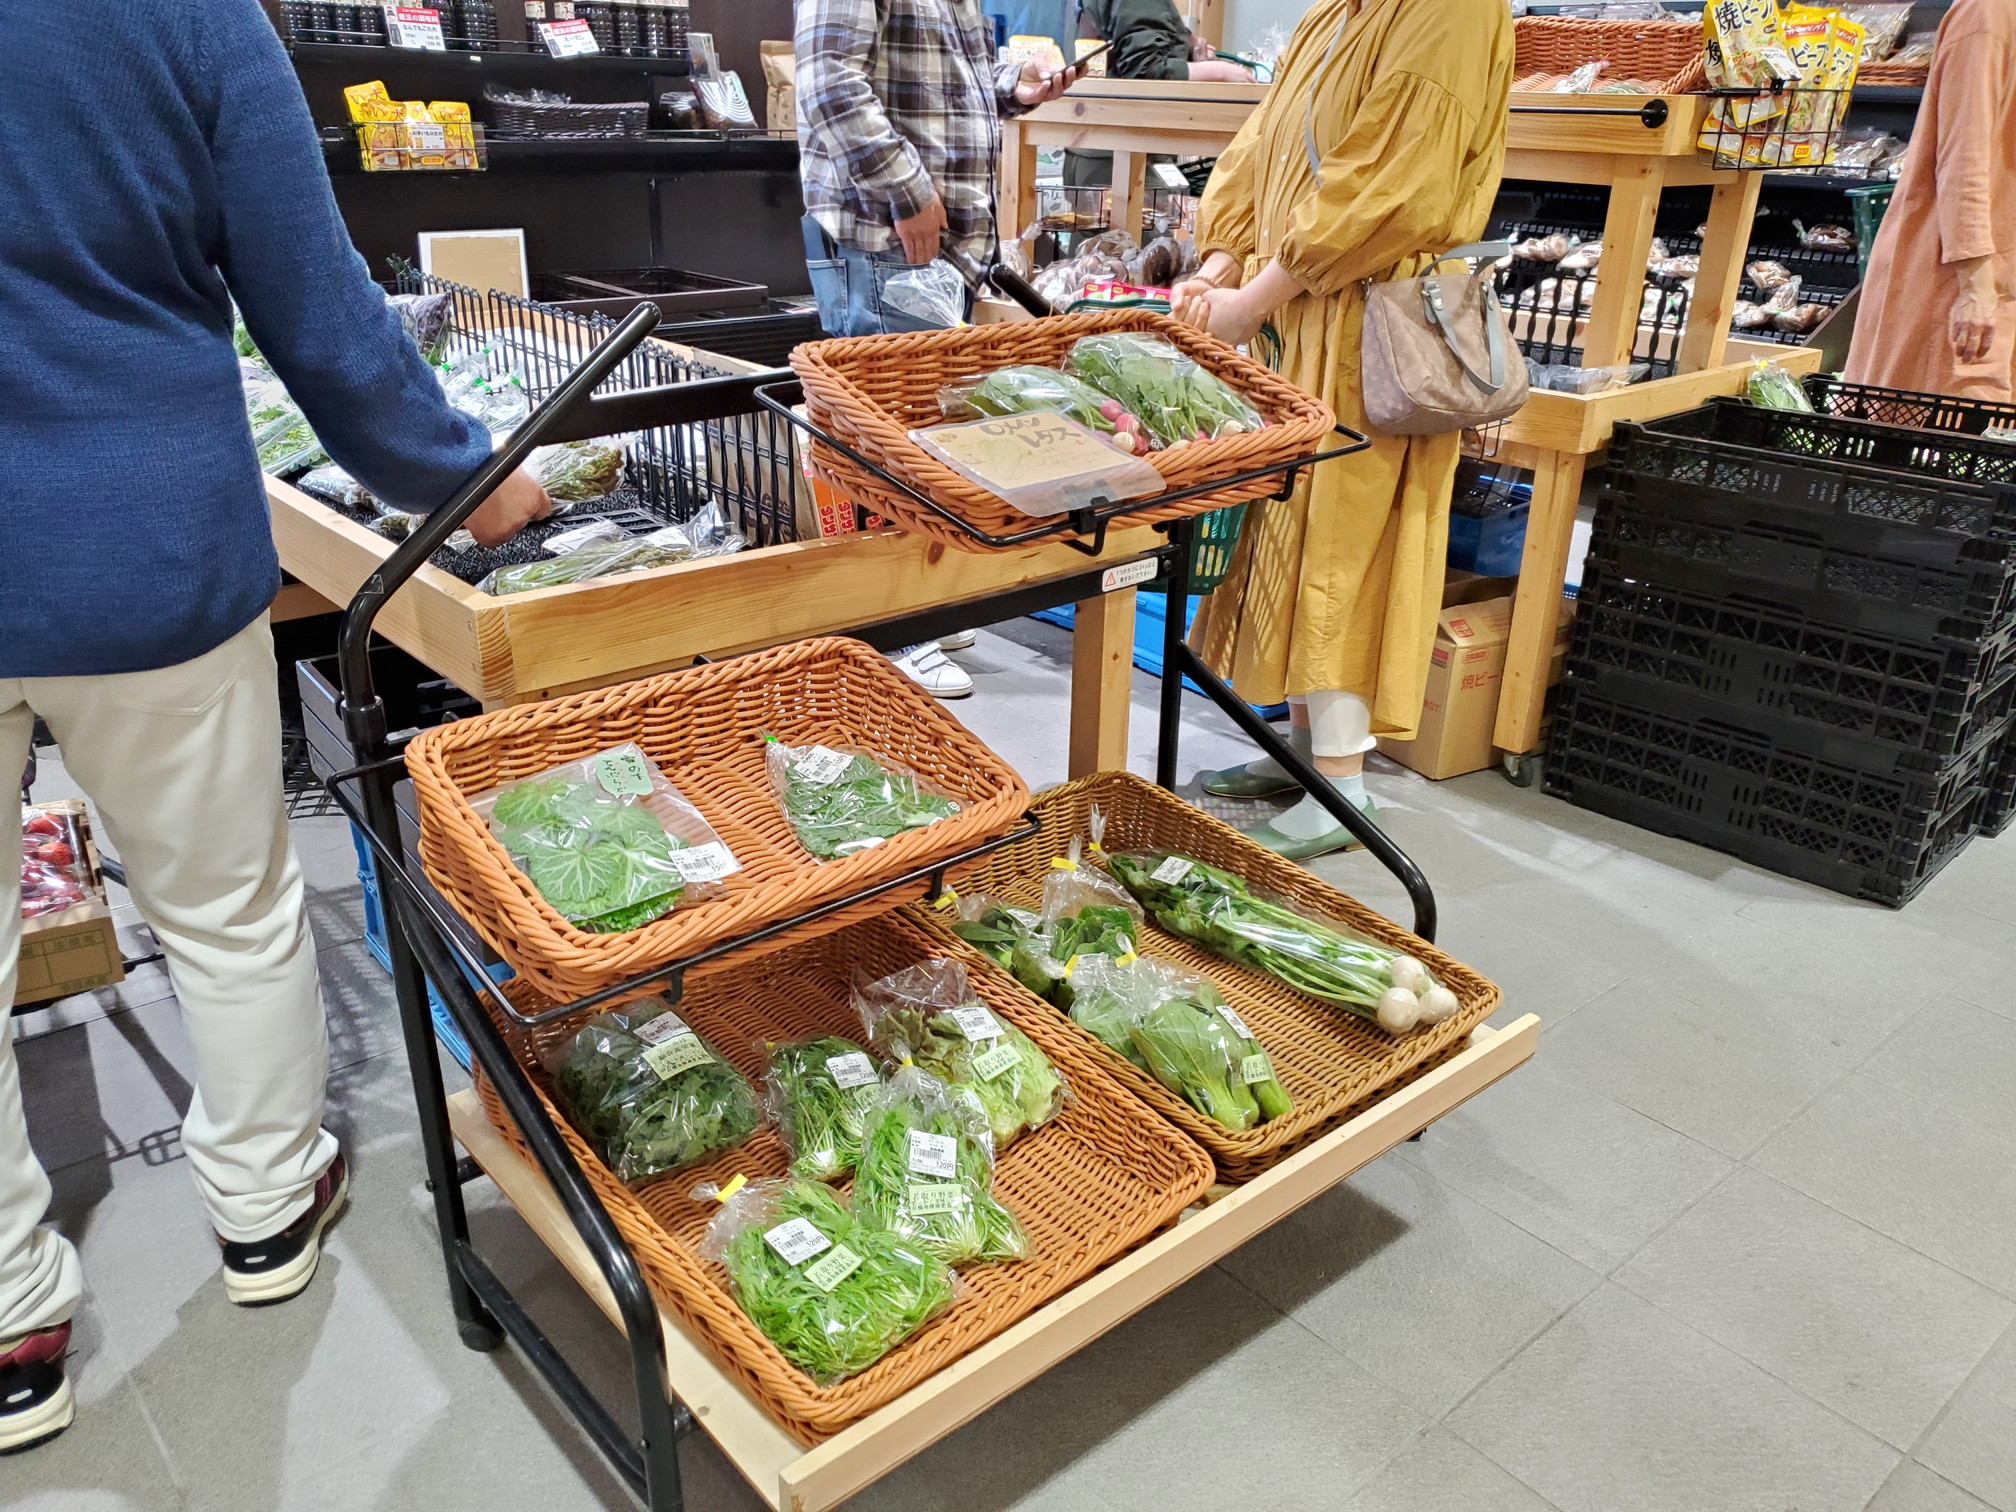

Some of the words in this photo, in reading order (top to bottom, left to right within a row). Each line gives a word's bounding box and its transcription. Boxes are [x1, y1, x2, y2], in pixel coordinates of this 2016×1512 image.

[1016, 426, 1081, 448] レタス
[820, 505, 838, 537] タンサ
[936, 1161, 954, 1171] 120円
[806, 1235, 825, 1247] 120円
